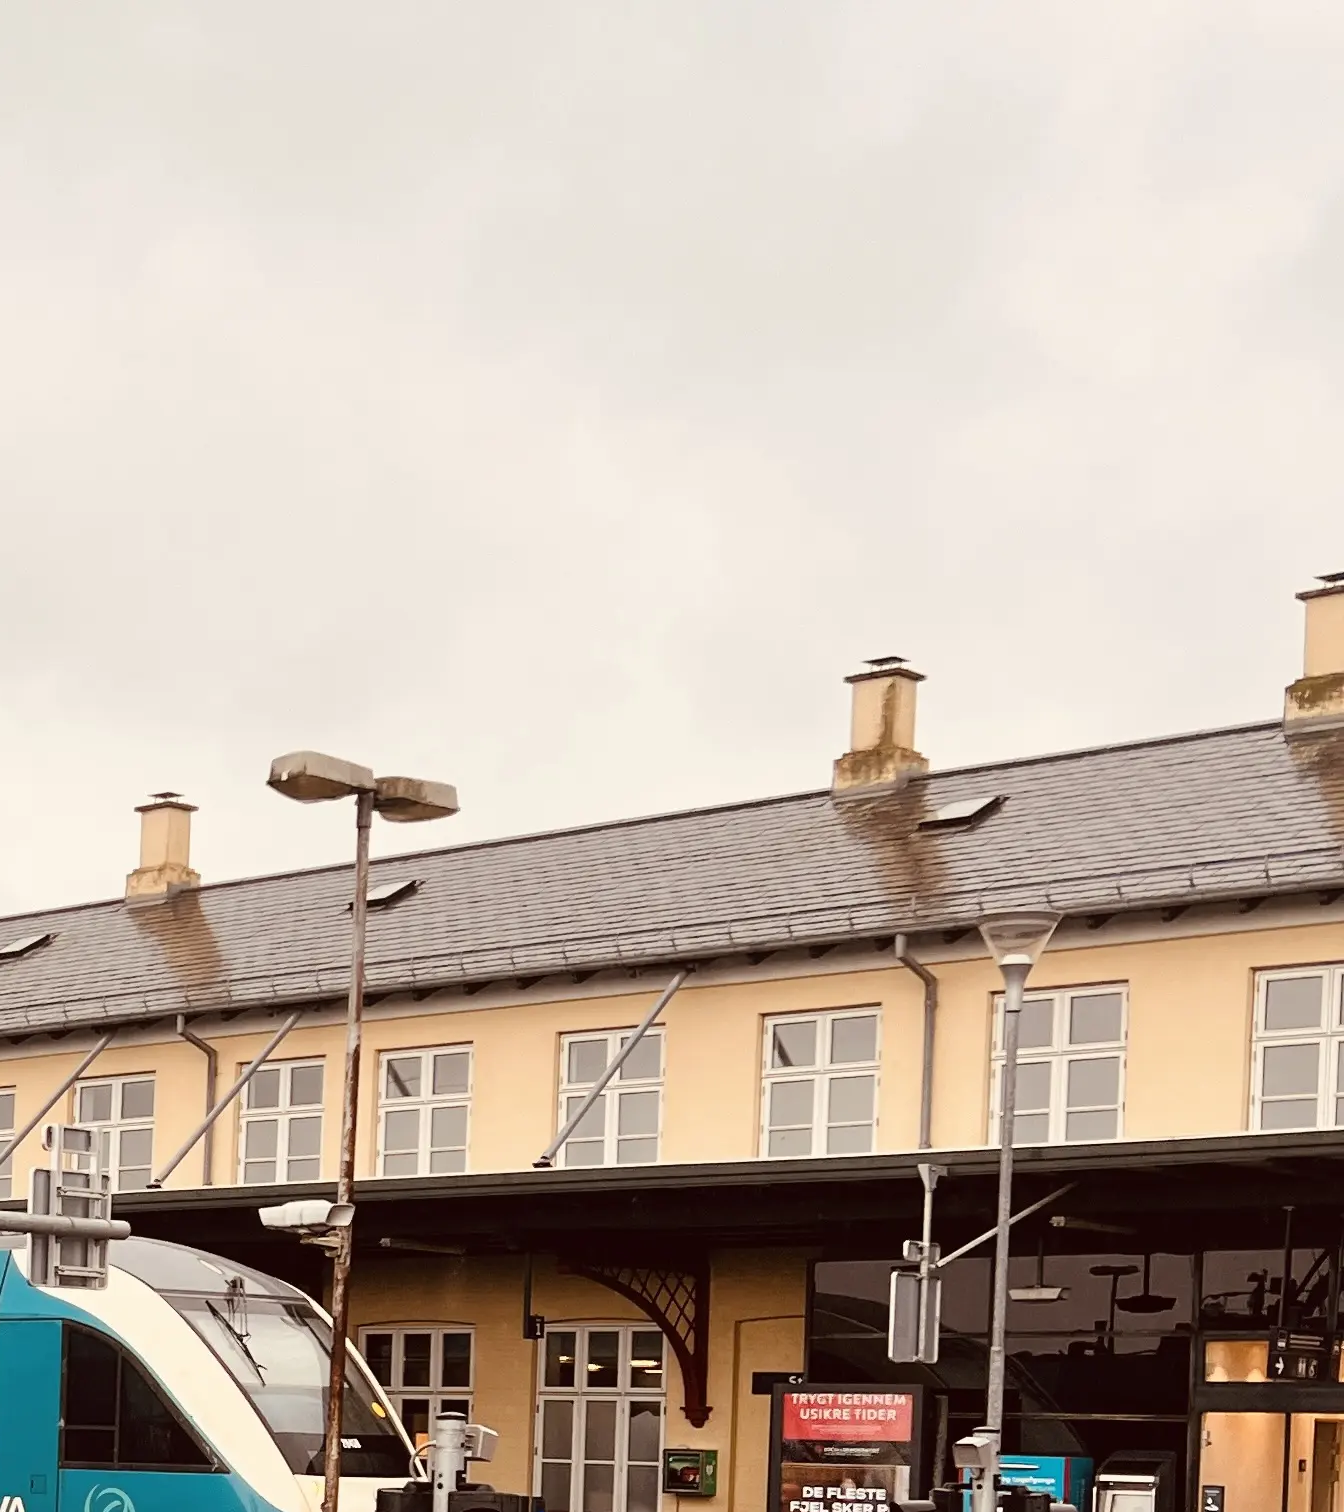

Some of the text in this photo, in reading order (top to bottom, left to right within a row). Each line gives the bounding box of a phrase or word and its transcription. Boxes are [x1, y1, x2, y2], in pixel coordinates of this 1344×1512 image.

[799, 1408, 897, 1420] USIKRE TIDER
[802, 1486, 887, 1500] DE FLESTE
